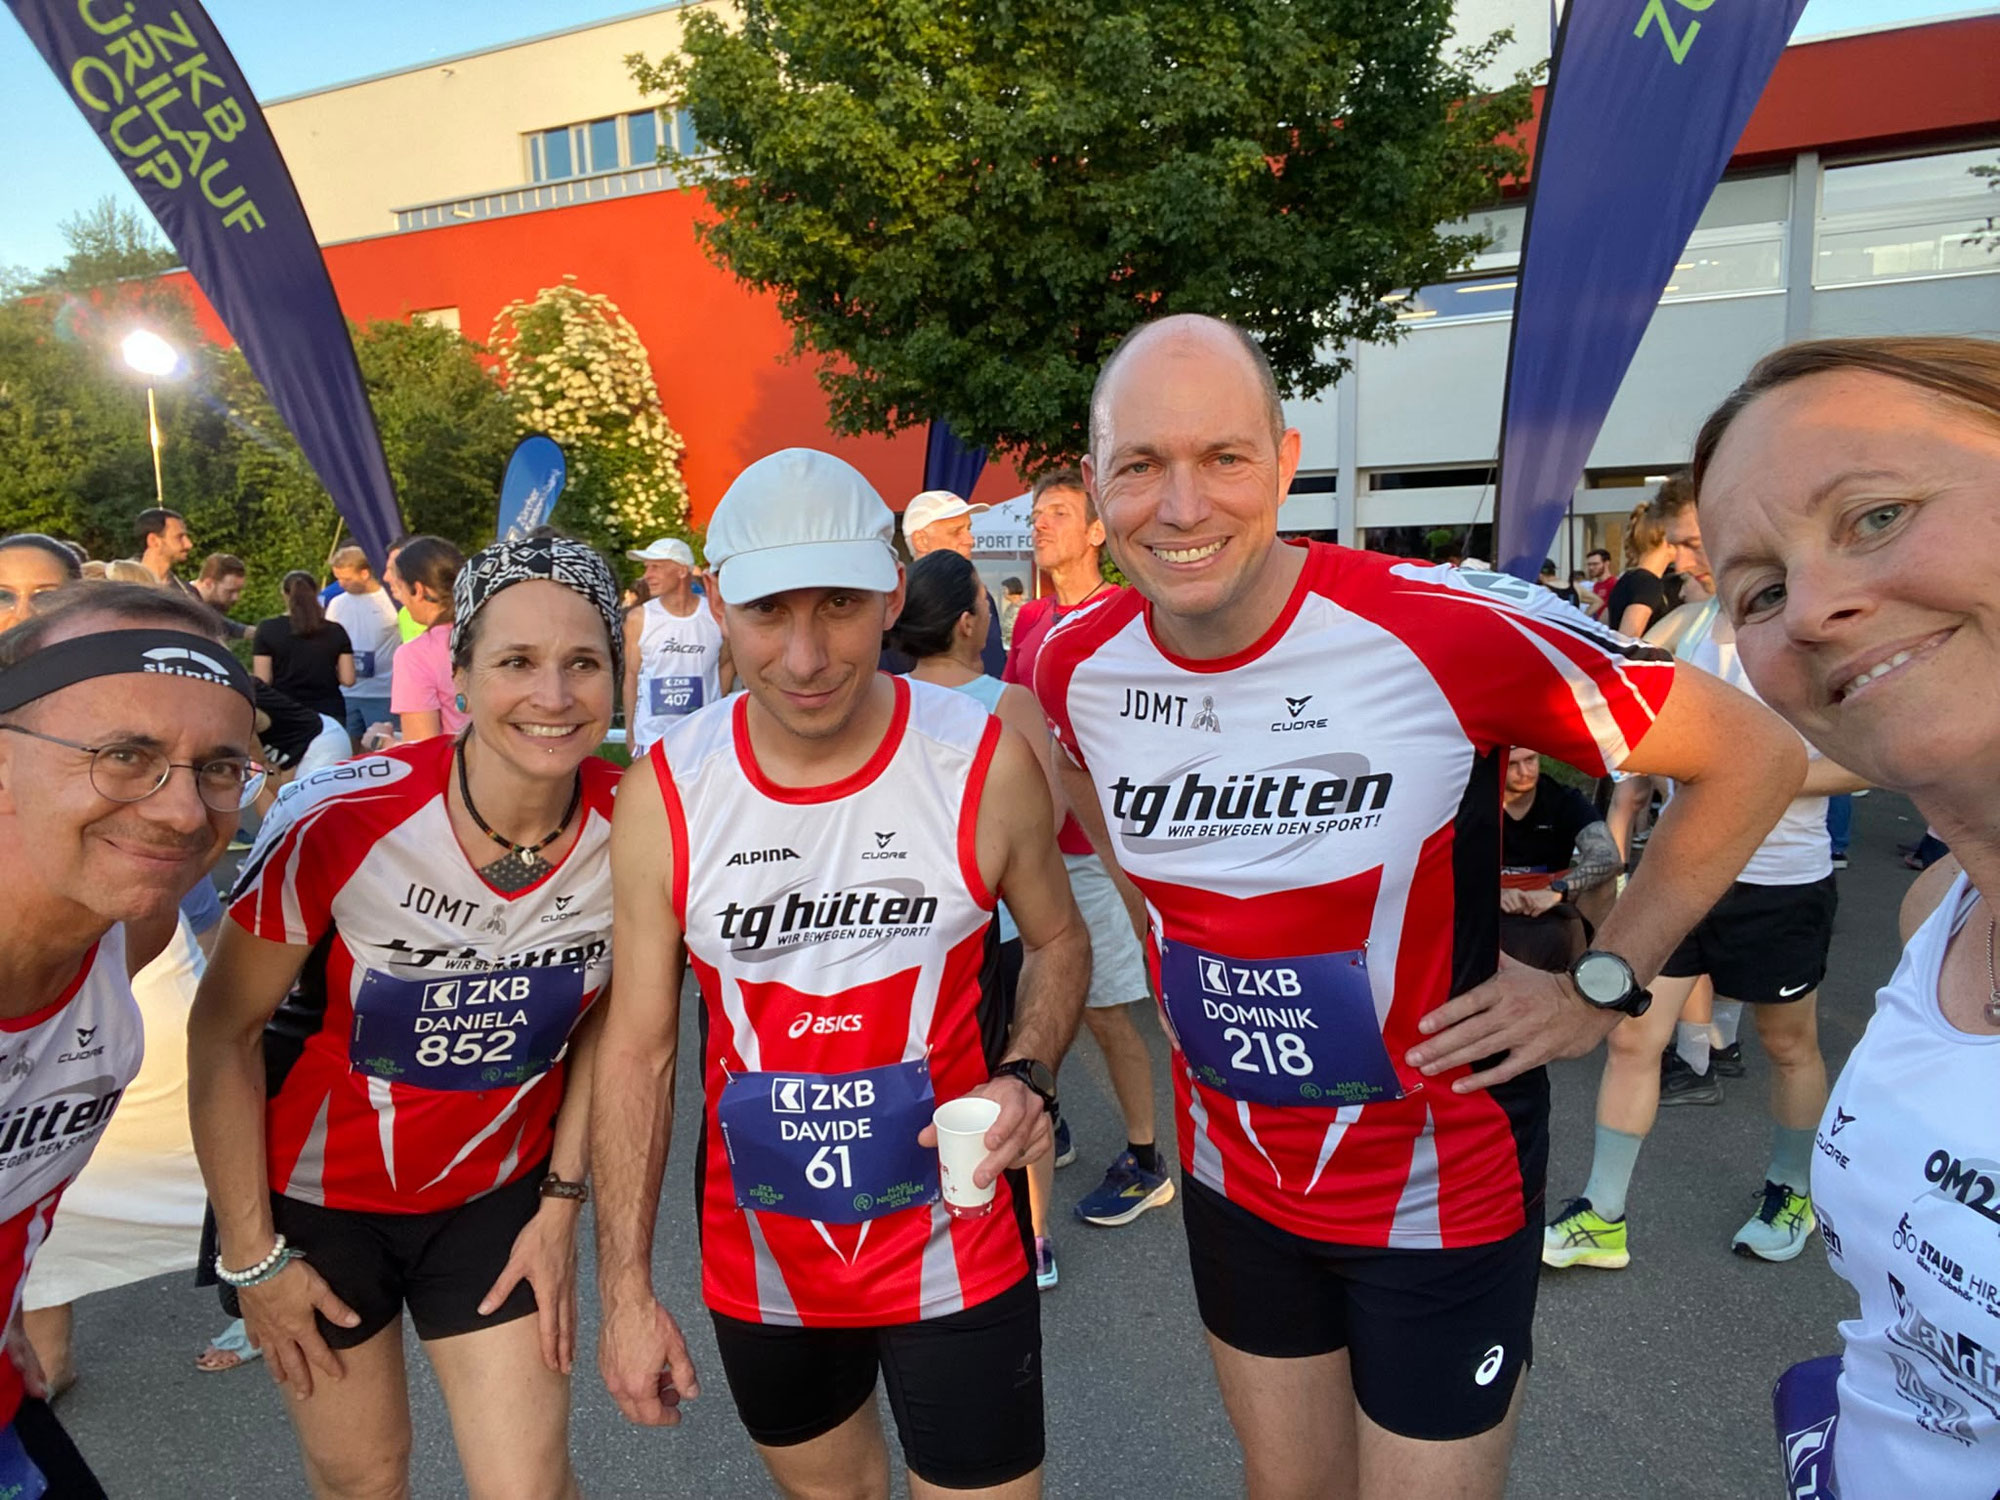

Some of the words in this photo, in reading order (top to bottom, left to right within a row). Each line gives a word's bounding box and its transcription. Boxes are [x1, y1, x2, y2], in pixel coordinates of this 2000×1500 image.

[144, 10, 247, 142] ZKB
[71, 56, 182, 189] CUP
[664, 693, 690, 706] 407
[1120, 688, 1188, 727] JDMT
[1271, 718, 1328, 732] CUORE
[1107, 776, 1171, 837] tg
[1172, 773, 1393, 821] hütten
[1167, 825, 1194, 838] WIR
[1198, 823, 1273, 837] BEWEGEN
[1277, 821, 1310, 835] DEN
[1314, 814, 1383, 834] SPORT!
[726, 847, 801, 867] ALPINA
[861, 851, 908, 860] CUORE
[400, 883, 480, 927] JDMT
[714, 902, 775, 952] tg
[780, 892, 938, 933] hütten
[777, 933, 801, 946] WIR
[803, 929, 855, 943] BEWEGEN
[858, 928, 883, 939] DEN
[885, 926, 930, 939] SPORT!
[445, 960, 472, 970] WIR
[465, 976, 530, 1005] ZKB
[1231, 968, 1302, 997] ZKB
[414, 1009, 528, 1033] DANIELA
[1202, 998, 1319, 1029] DOMINIK
[416, 1030, 516, 1067] 852
[1223, 1027, 1314, 1077] 218
[811, 1079, 875, 1110] ZKB
[780, 1117, 872, 1141] DAVIDE
[34, 1140, 65, 1159] DEN
[805, 1145, 852, 1189] 61
[1924, 1149, 2000, 1224] OM2
[1919, 1239, 1964, 1283] STAUB
[1969, 1274, 2000, 1306] HIR
